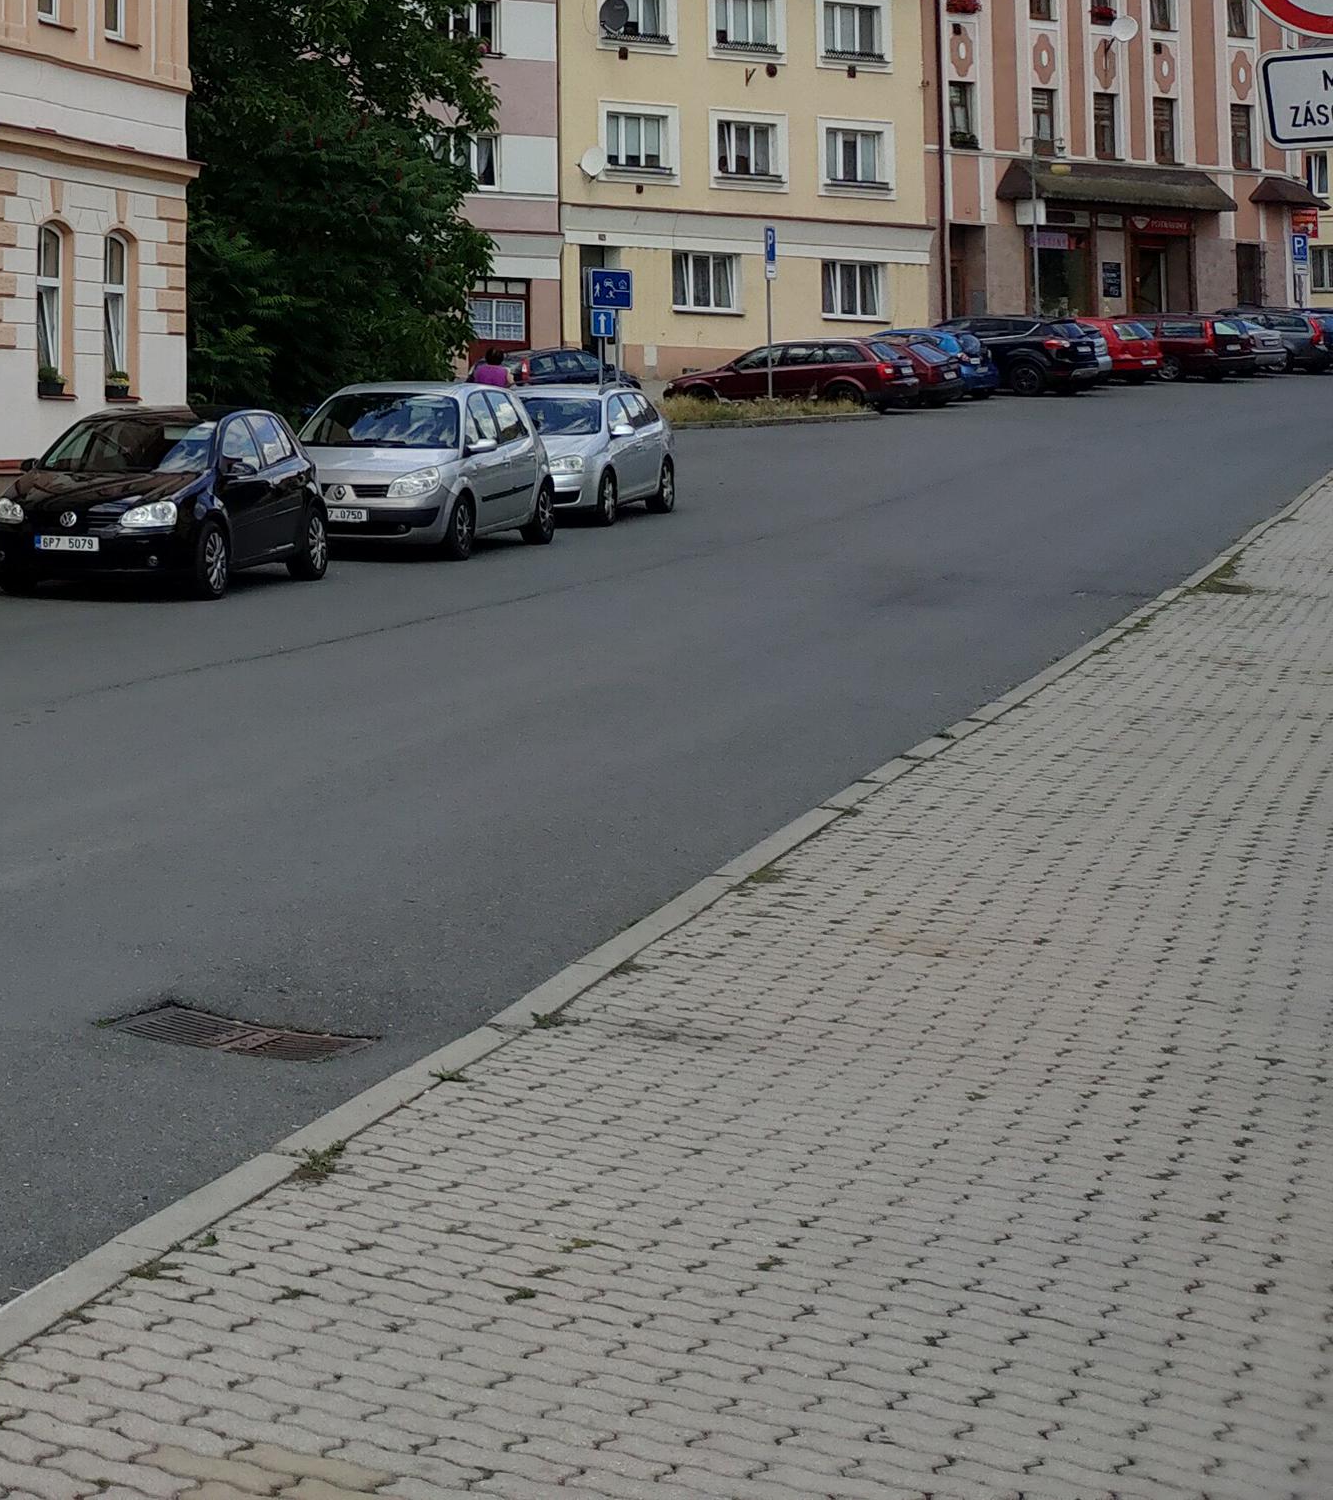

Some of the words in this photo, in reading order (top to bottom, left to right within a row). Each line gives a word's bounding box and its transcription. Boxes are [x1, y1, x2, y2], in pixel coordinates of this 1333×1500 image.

[1289, 100, 1333, 128] ZÁS
[340, 510, 363, 520] 0750
[43, 537, 61, 548] 6P7
[68, 538, 94, 550] 5079
